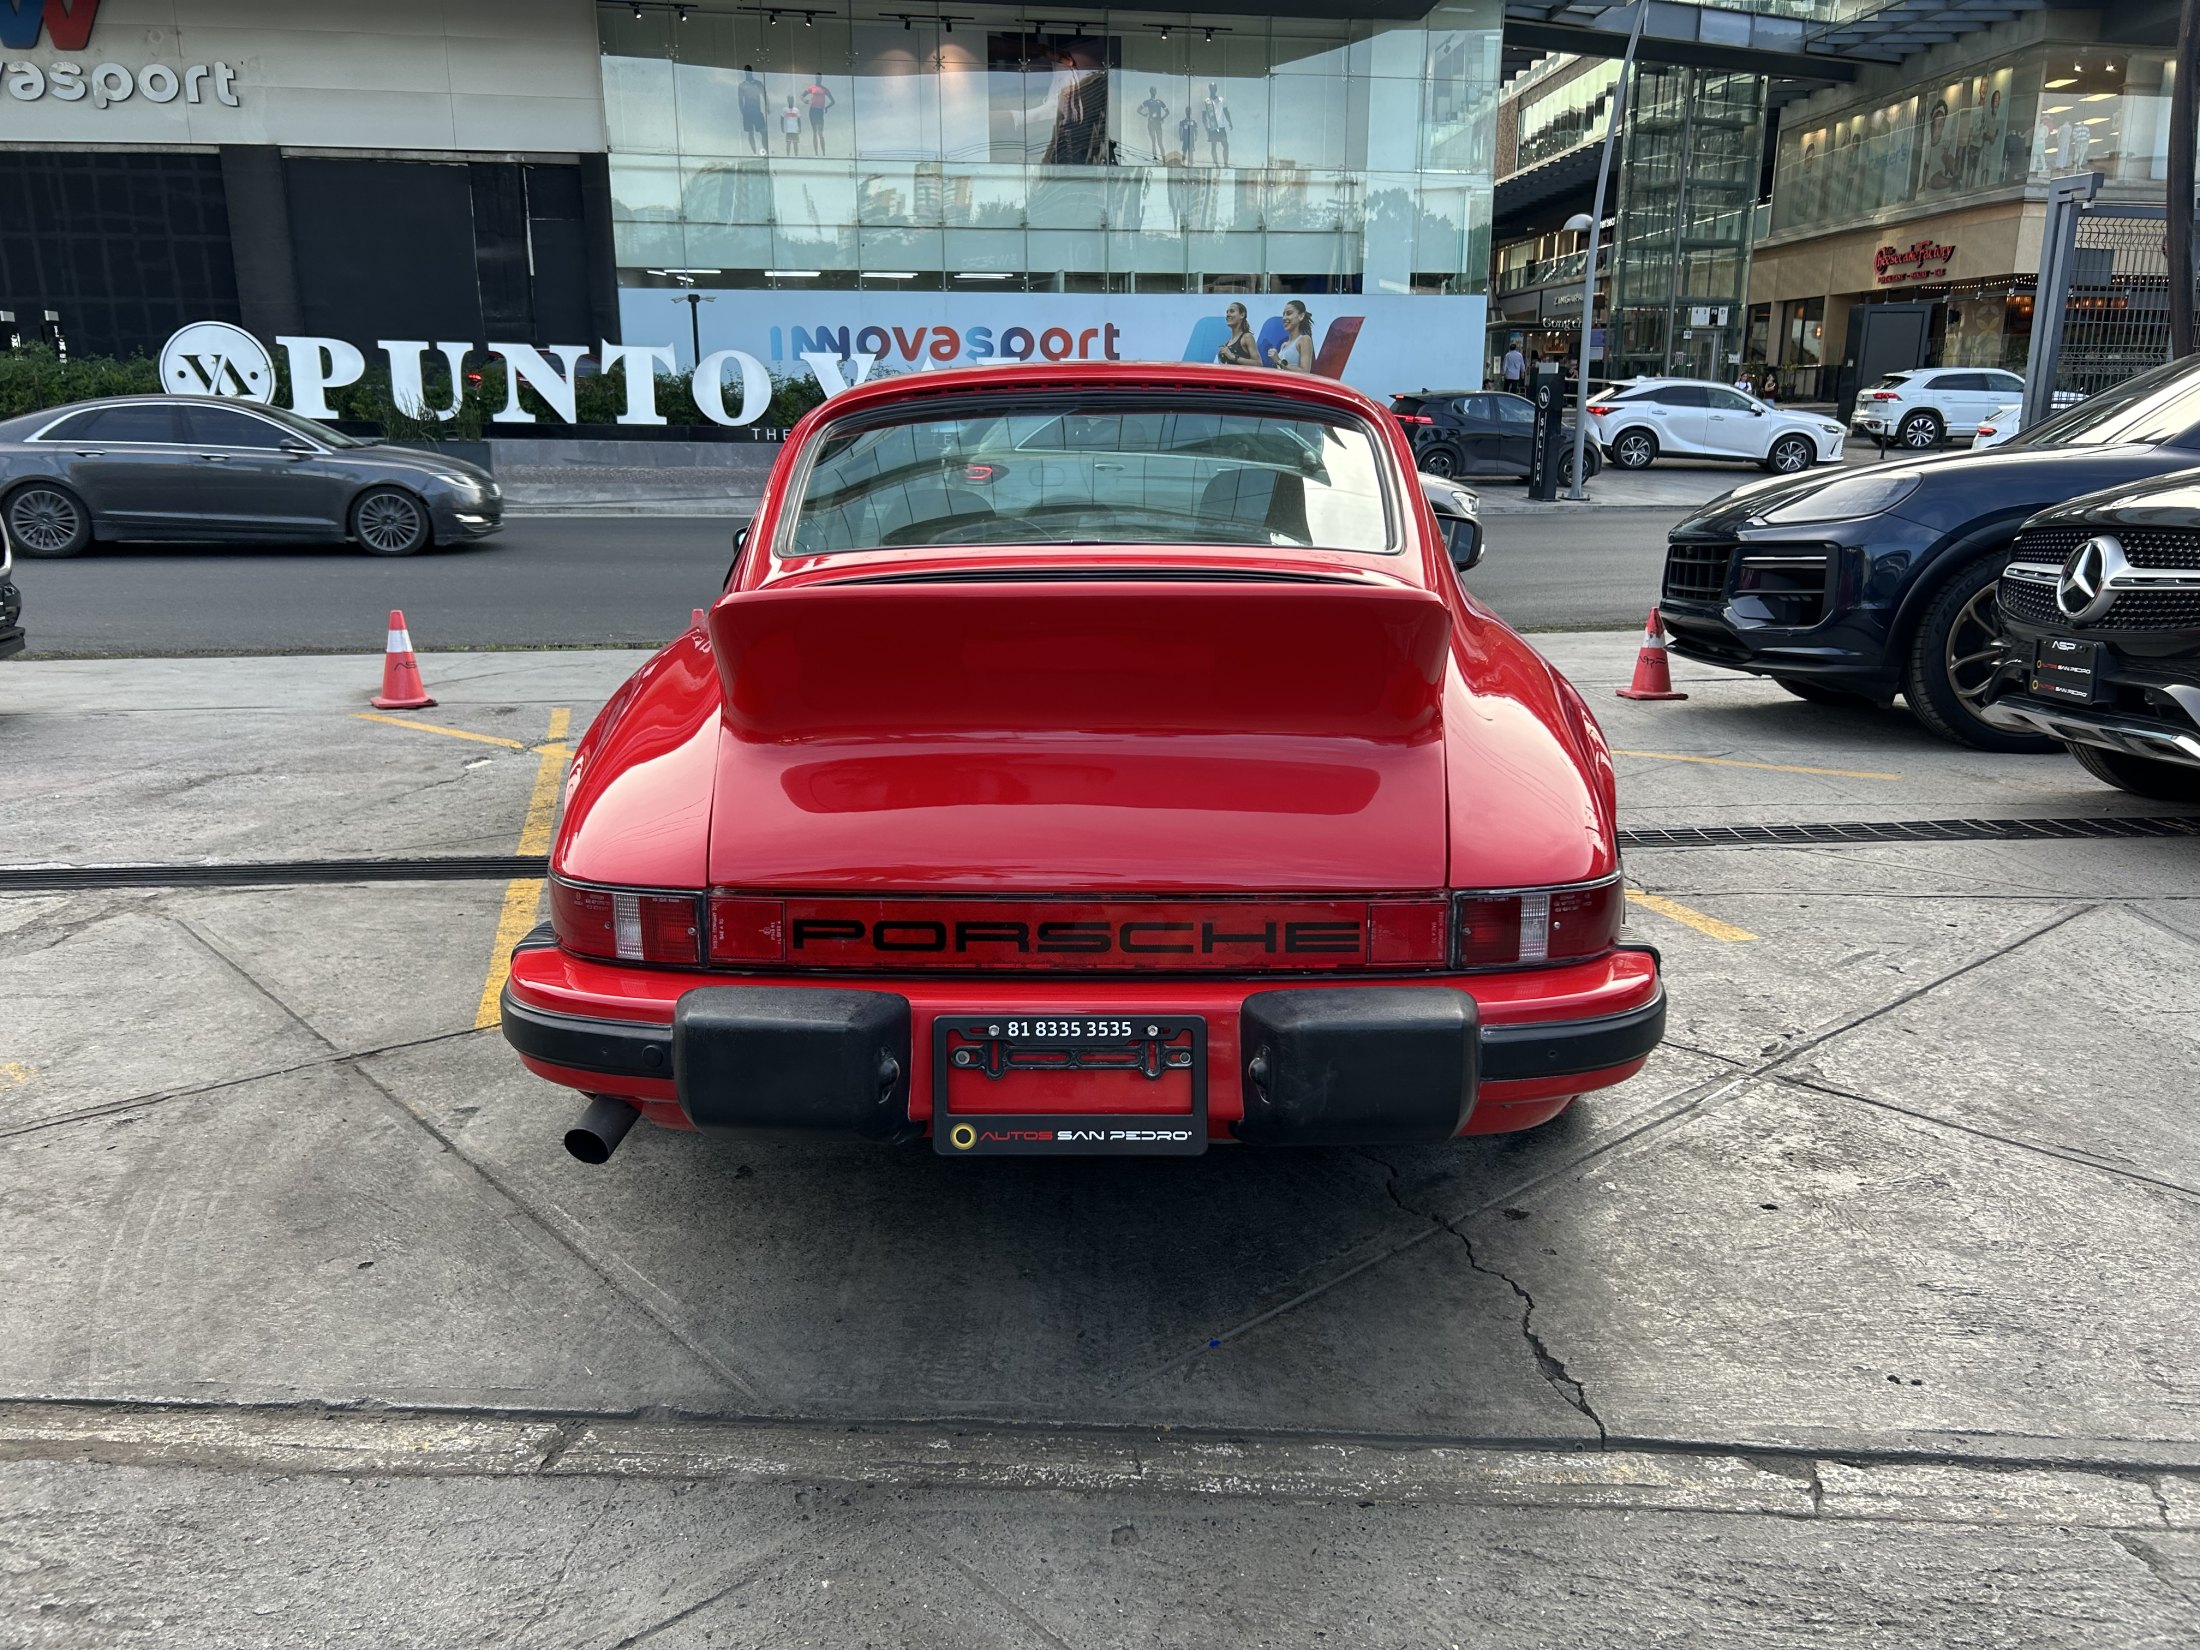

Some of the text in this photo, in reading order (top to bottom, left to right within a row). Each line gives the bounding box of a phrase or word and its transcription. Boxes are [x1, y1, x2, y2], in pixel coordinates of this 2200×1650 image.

[0, 60, 239, 109] asport
[1542, 317, 1583, 331] Gong ch
[275, 336, 772, 428] PUNTO
[751, 428, 791, 441] THE
[1536, 417, 1545, 482] SALIDA
[2052, 641, 2076, 651] ASP
[792, 918, 1360, 953] PORSCHE
[1007, 1021, 1132, 1037] 81 8335 3535
[980, 1130, 1054, 1141] AUTOS
[1057, 1131, 1105, 1141] SAN
